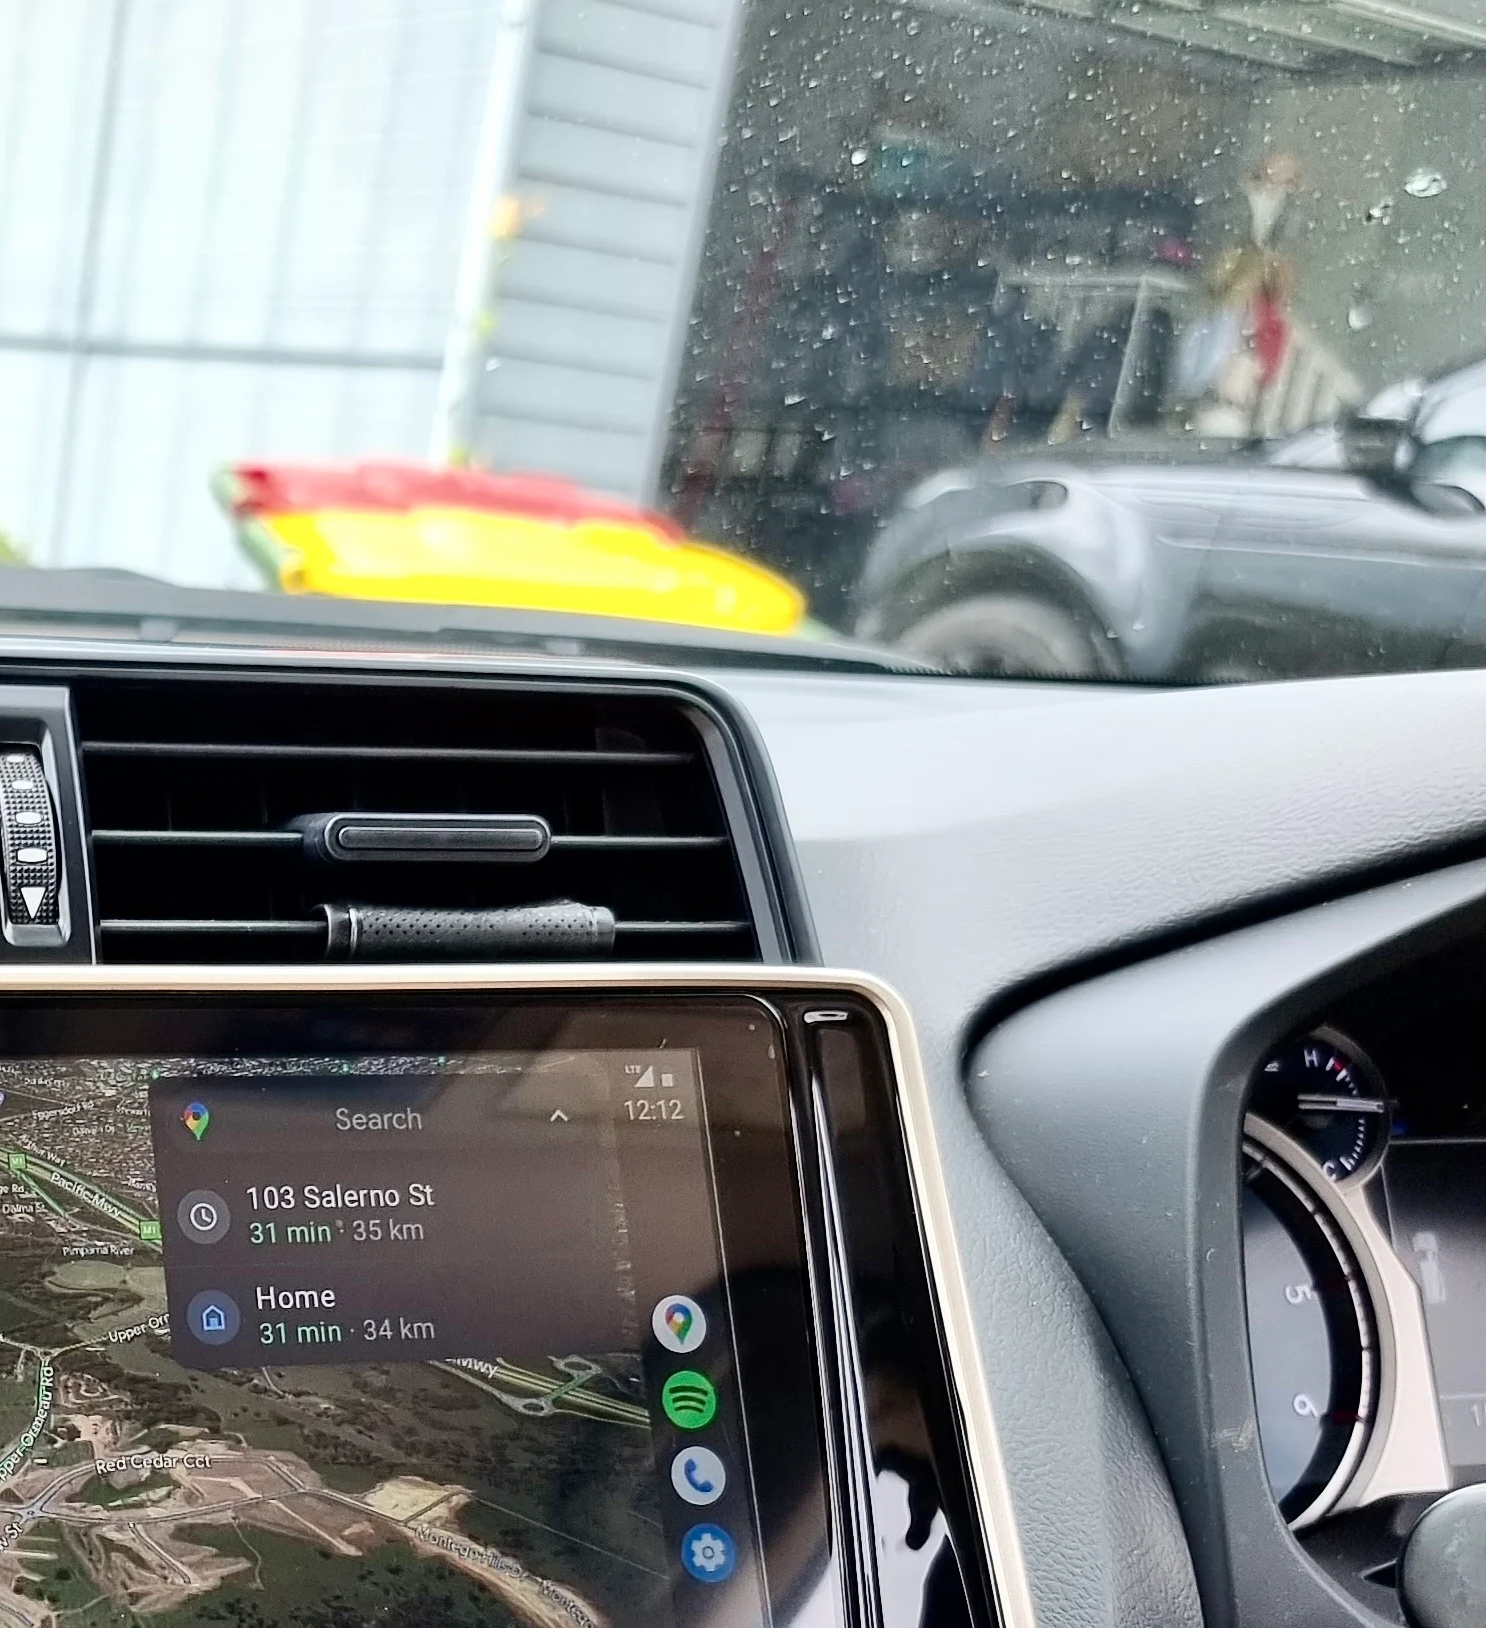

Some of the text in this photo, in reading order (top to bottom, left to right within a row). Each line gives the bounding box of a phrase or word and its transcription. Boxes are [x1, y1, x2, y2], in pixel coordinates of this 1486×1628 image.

[624, 1064, 642, 1074] LTE
[1303, 1048, 1319, 1068] H
[335, 1106, 423, 1131] Search
[623, 1099, 685, 1121] 12:12
[11, 1183, 25, 1194] Rd
[51, 1171, 92, 1203] Pacific
[246, 1183, 435, 1210] 103 Salerno St
[249, 1218, 425, 1244] 31 min 35 km
[62, 1245, 135, 1257] Pimpama River
[255, 1285, 337, 1311] Home
[1284, 1284, 1314, 1306] 5
[108, 1323, 147, 1344] Upper
[259, 1317, 436, 1344] 31 min 34 km
[20, 1390, 54, 1448] Ormeau
[39, 1366, 55, 1387] Rd
[1291, 1393, 1320, 1419] 6
[96, 1455, 212, 1474] Red Cedar Cct
[3, 1521, 23, 1542] St
